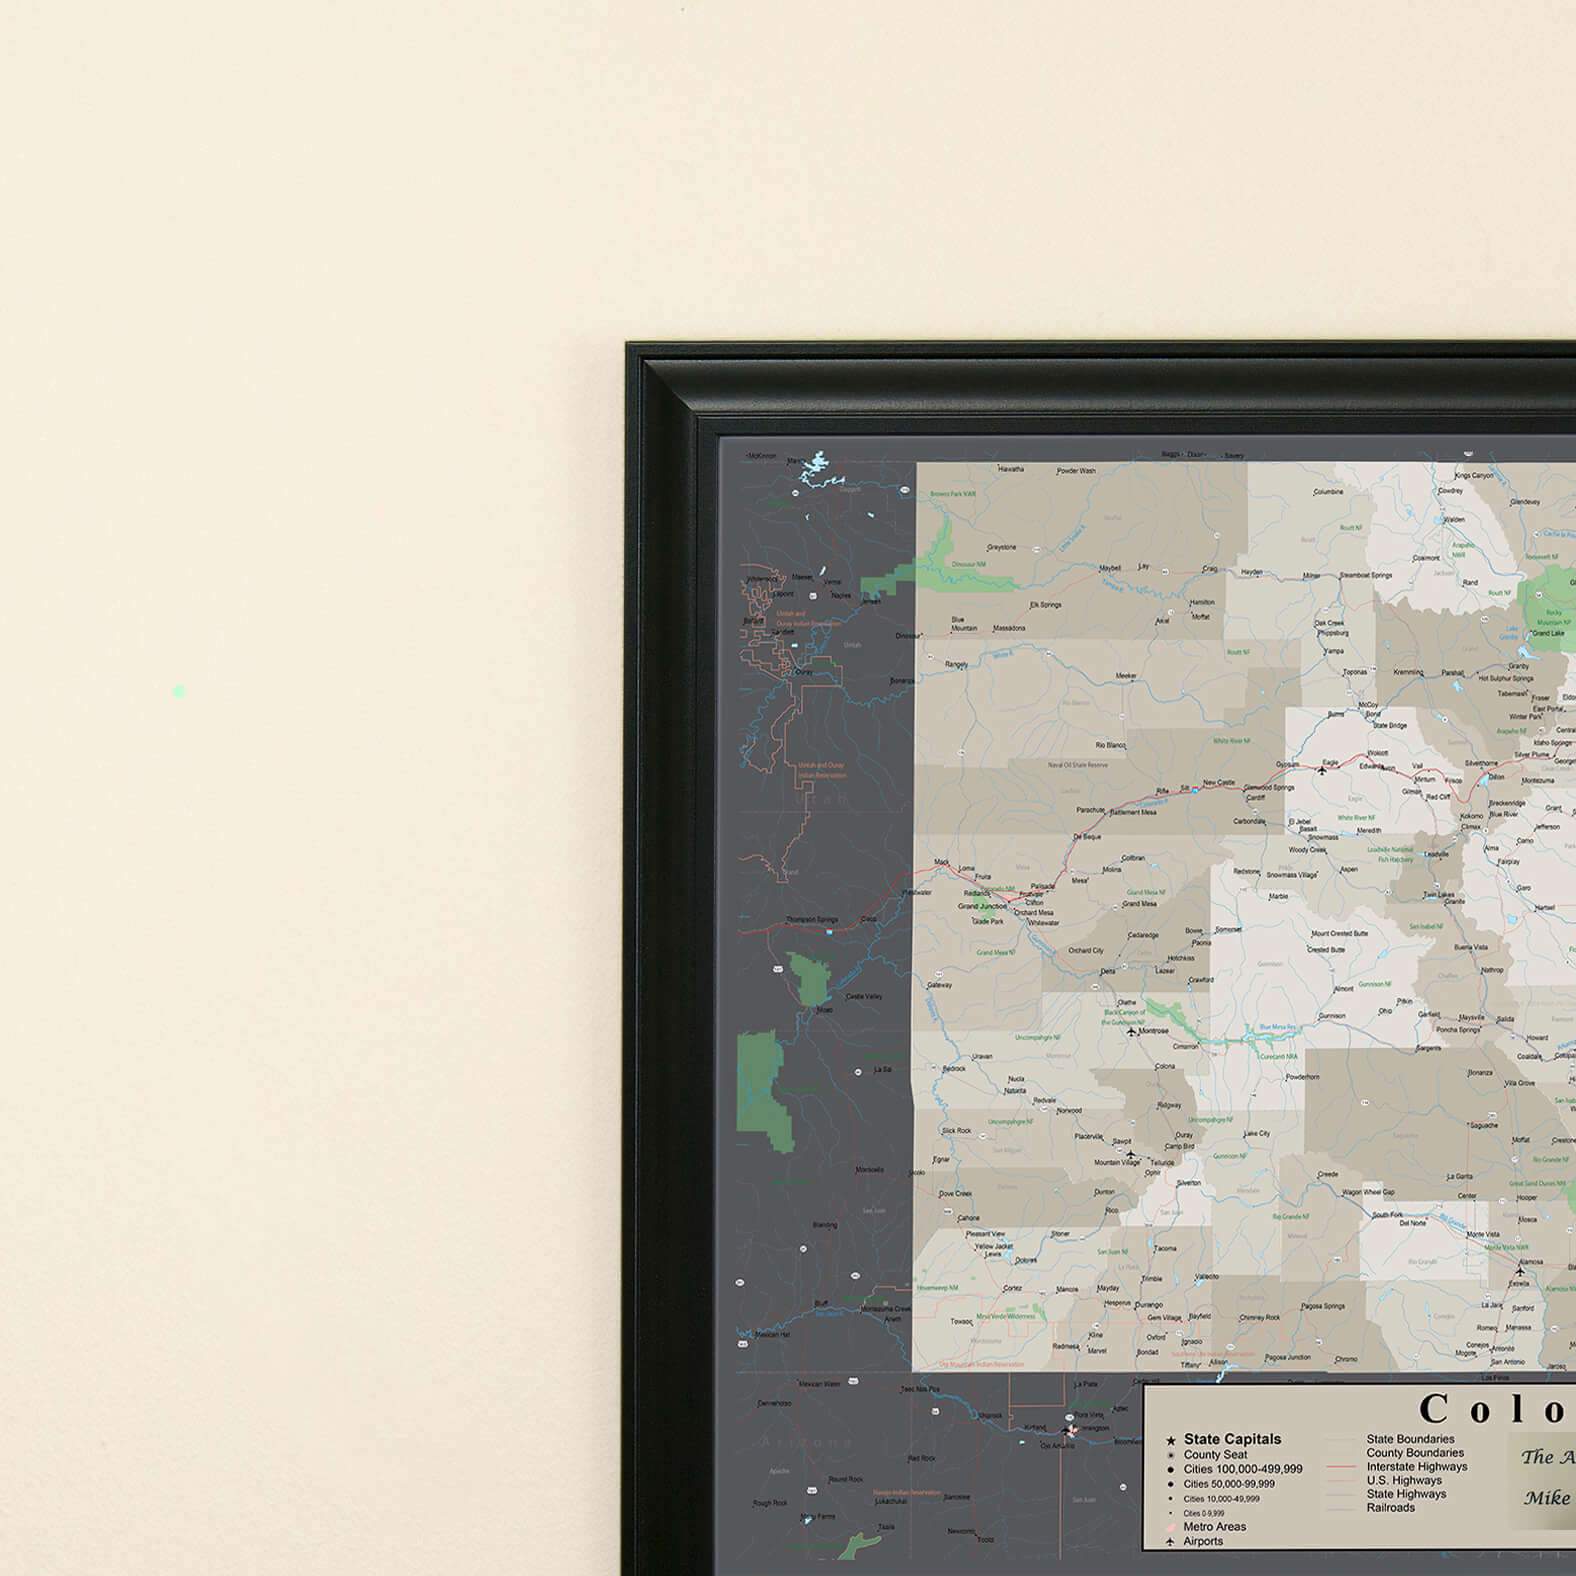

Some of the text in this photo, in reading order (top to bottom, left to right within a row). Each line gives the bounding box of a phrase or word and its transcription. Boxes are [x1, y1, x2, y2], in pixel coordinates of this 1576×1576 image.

[1185, 1433, 1281, 1447] State Capitals
[1367, 1434, 1455, 1444] State Boundaries
[1184, 1449, 1247, 1461] County Seat
[1367, 1448, 1464, 1459] County Boundaries
[1522, 1448, 1554, 1464] The
[1184, 1464, 1303, 1474] Cities 100,000-499,999
[1368, 1462, 1468, 1473] Interstate Highways
[1184, 1480, 1275, 1488] Cities 50,000-99,999
[1368, 1475, 1442, 1487] U.S. Highways
[1184, 1495, 1260, 1503] Cities 10,000-49,999
[1367, 1489, 1447, 1501] State Highways
[1524, 1490, 1571, 1505] Mike
[1367, 1503, 1415, 1512] Railroads
[1184, 1522, 1246, 1531] Metro Areas
[1184, 1536, 1223, 1547] Airports
